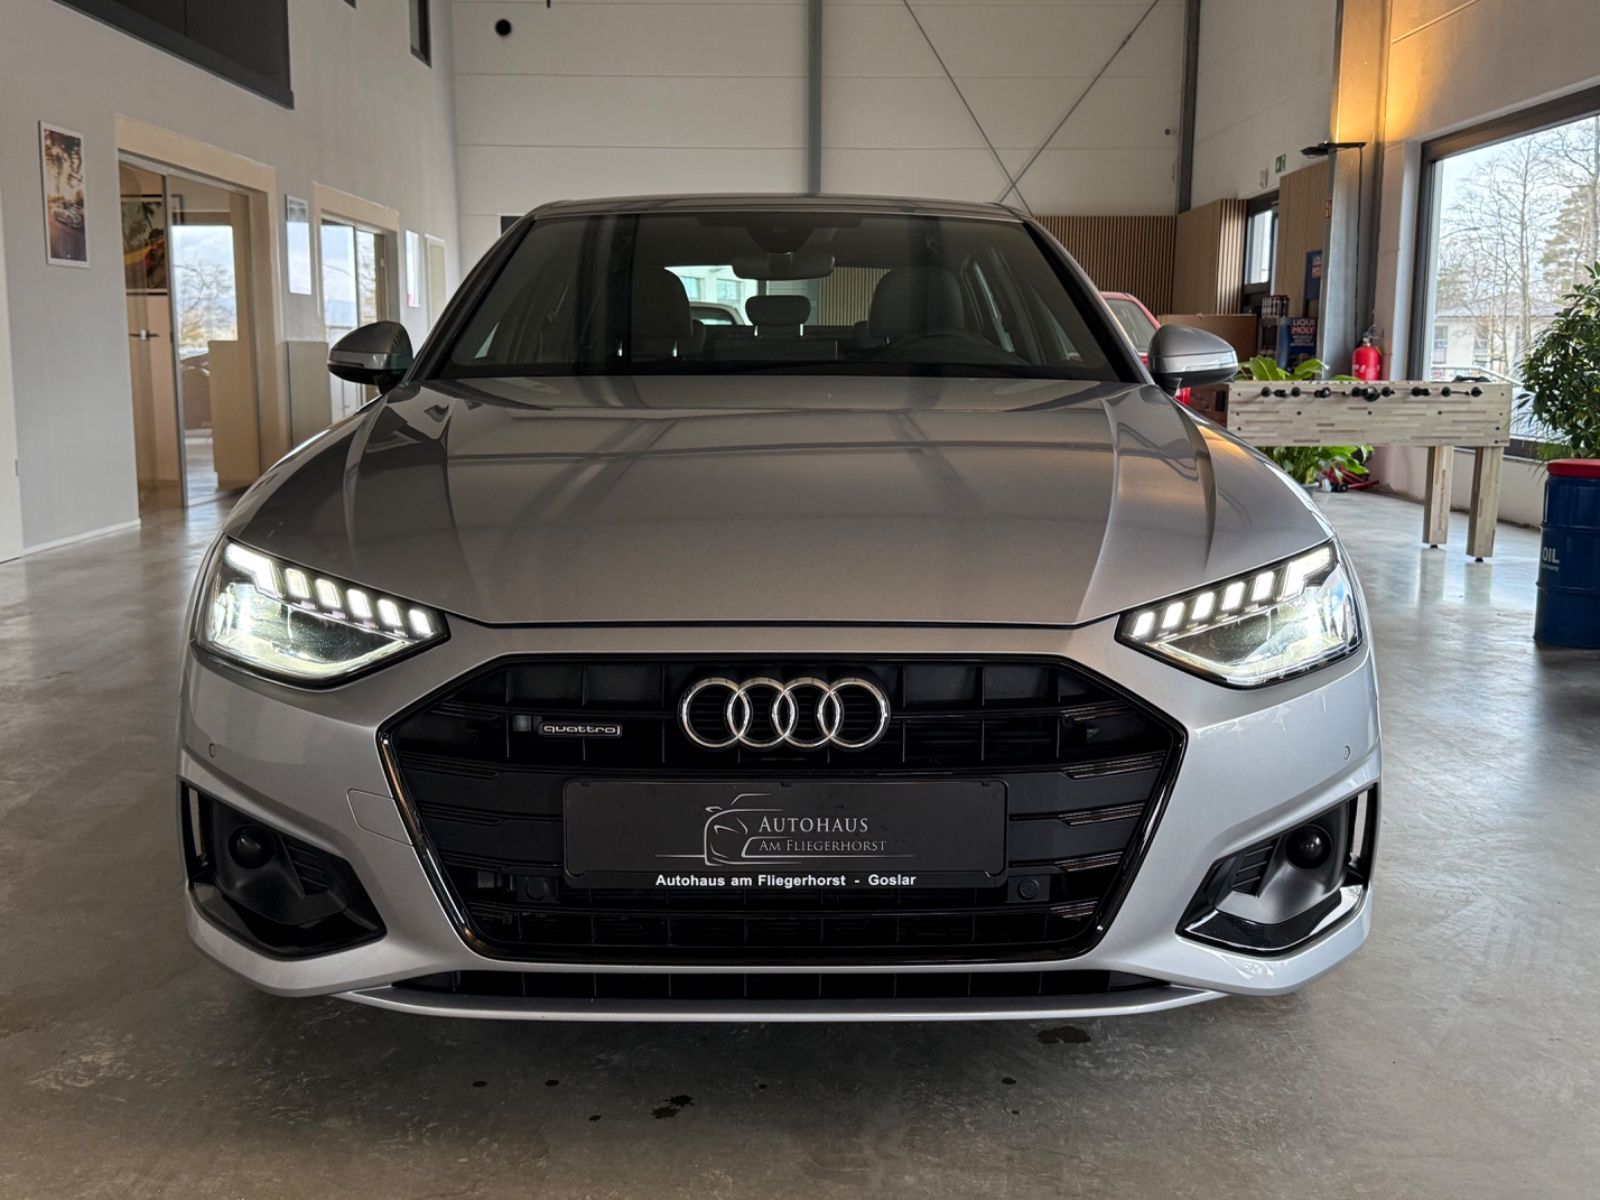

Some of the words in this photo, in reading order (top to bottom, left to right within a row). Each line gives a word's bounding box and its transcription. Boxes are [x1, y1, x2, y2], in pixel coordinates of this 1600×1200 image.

[1542, 546, 1560, 564] OIL
[543, 725, 616, 735] quattro
[758, 816, 868, 832] AUTOHAUS
[786, 839, 886, 852] FLIEGERHORST
[655, 874, 726, 887] Autohaus
[731, 877, 752, 887] am
[757, 874, 846, 889] Fliegerhorst
[868, 874, 916, 886] Goslar
